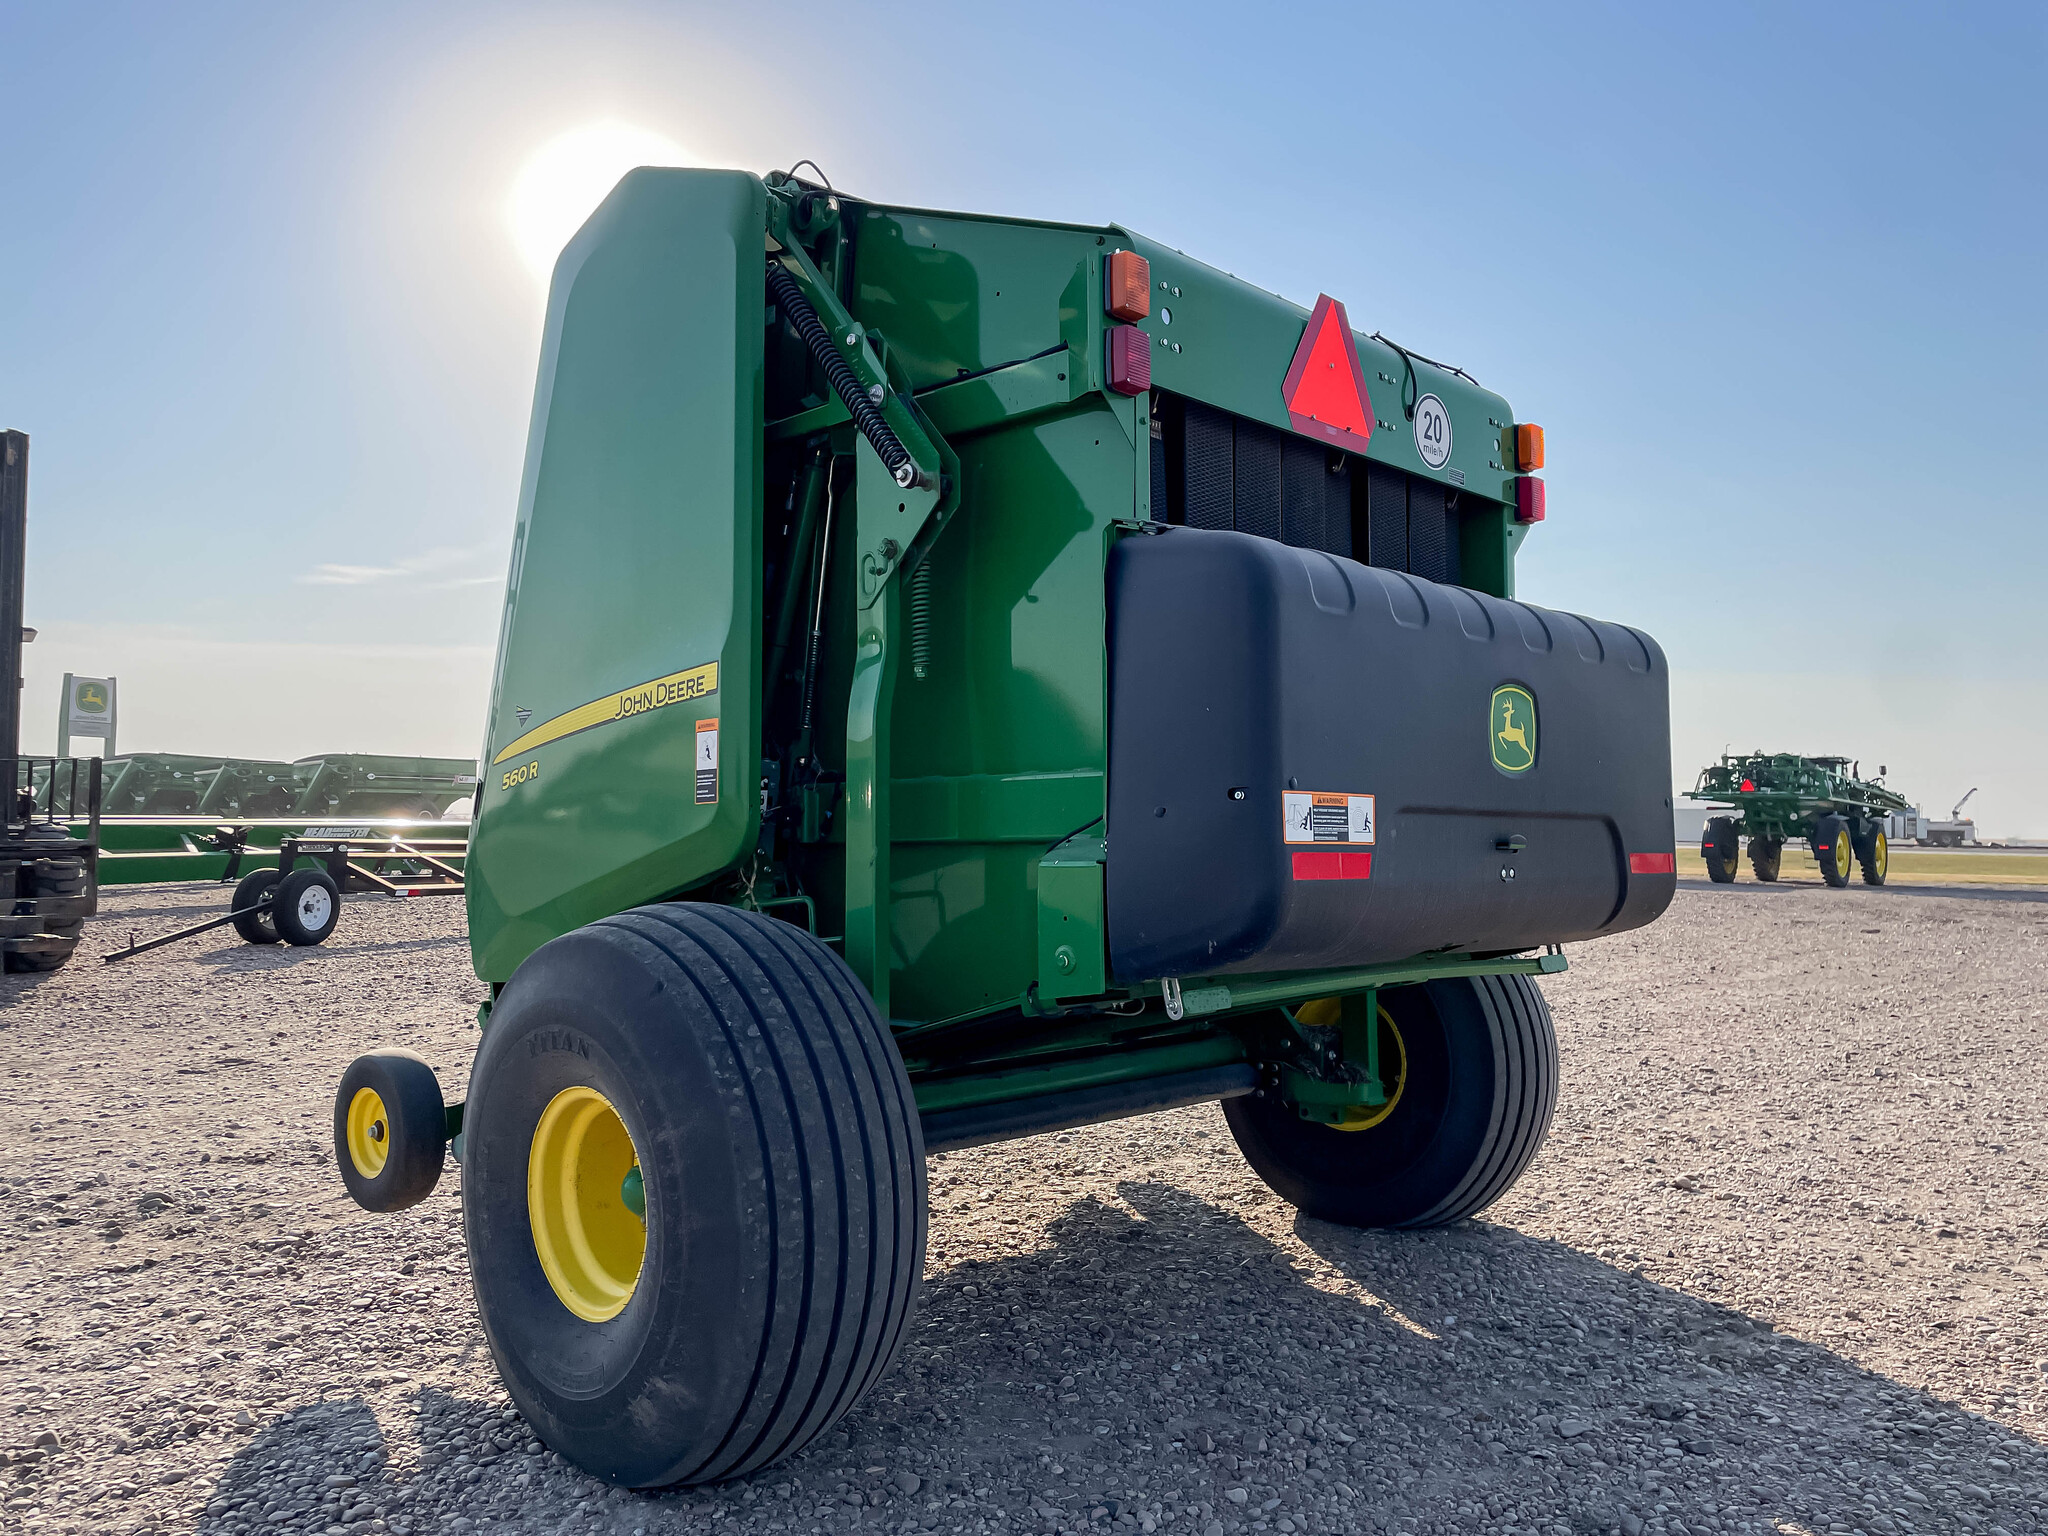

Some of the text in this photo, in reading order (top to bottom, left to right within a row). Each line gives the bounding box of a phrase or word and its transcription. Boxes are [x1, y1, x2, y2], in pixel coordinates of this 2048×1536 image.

[1424, 411, 1442, 443] 20
[615, 675, 706, 717] JOHN DEERE
[502, 760, 538, 791] 560 R
[527, 1030, 591, 1060] TITAN
